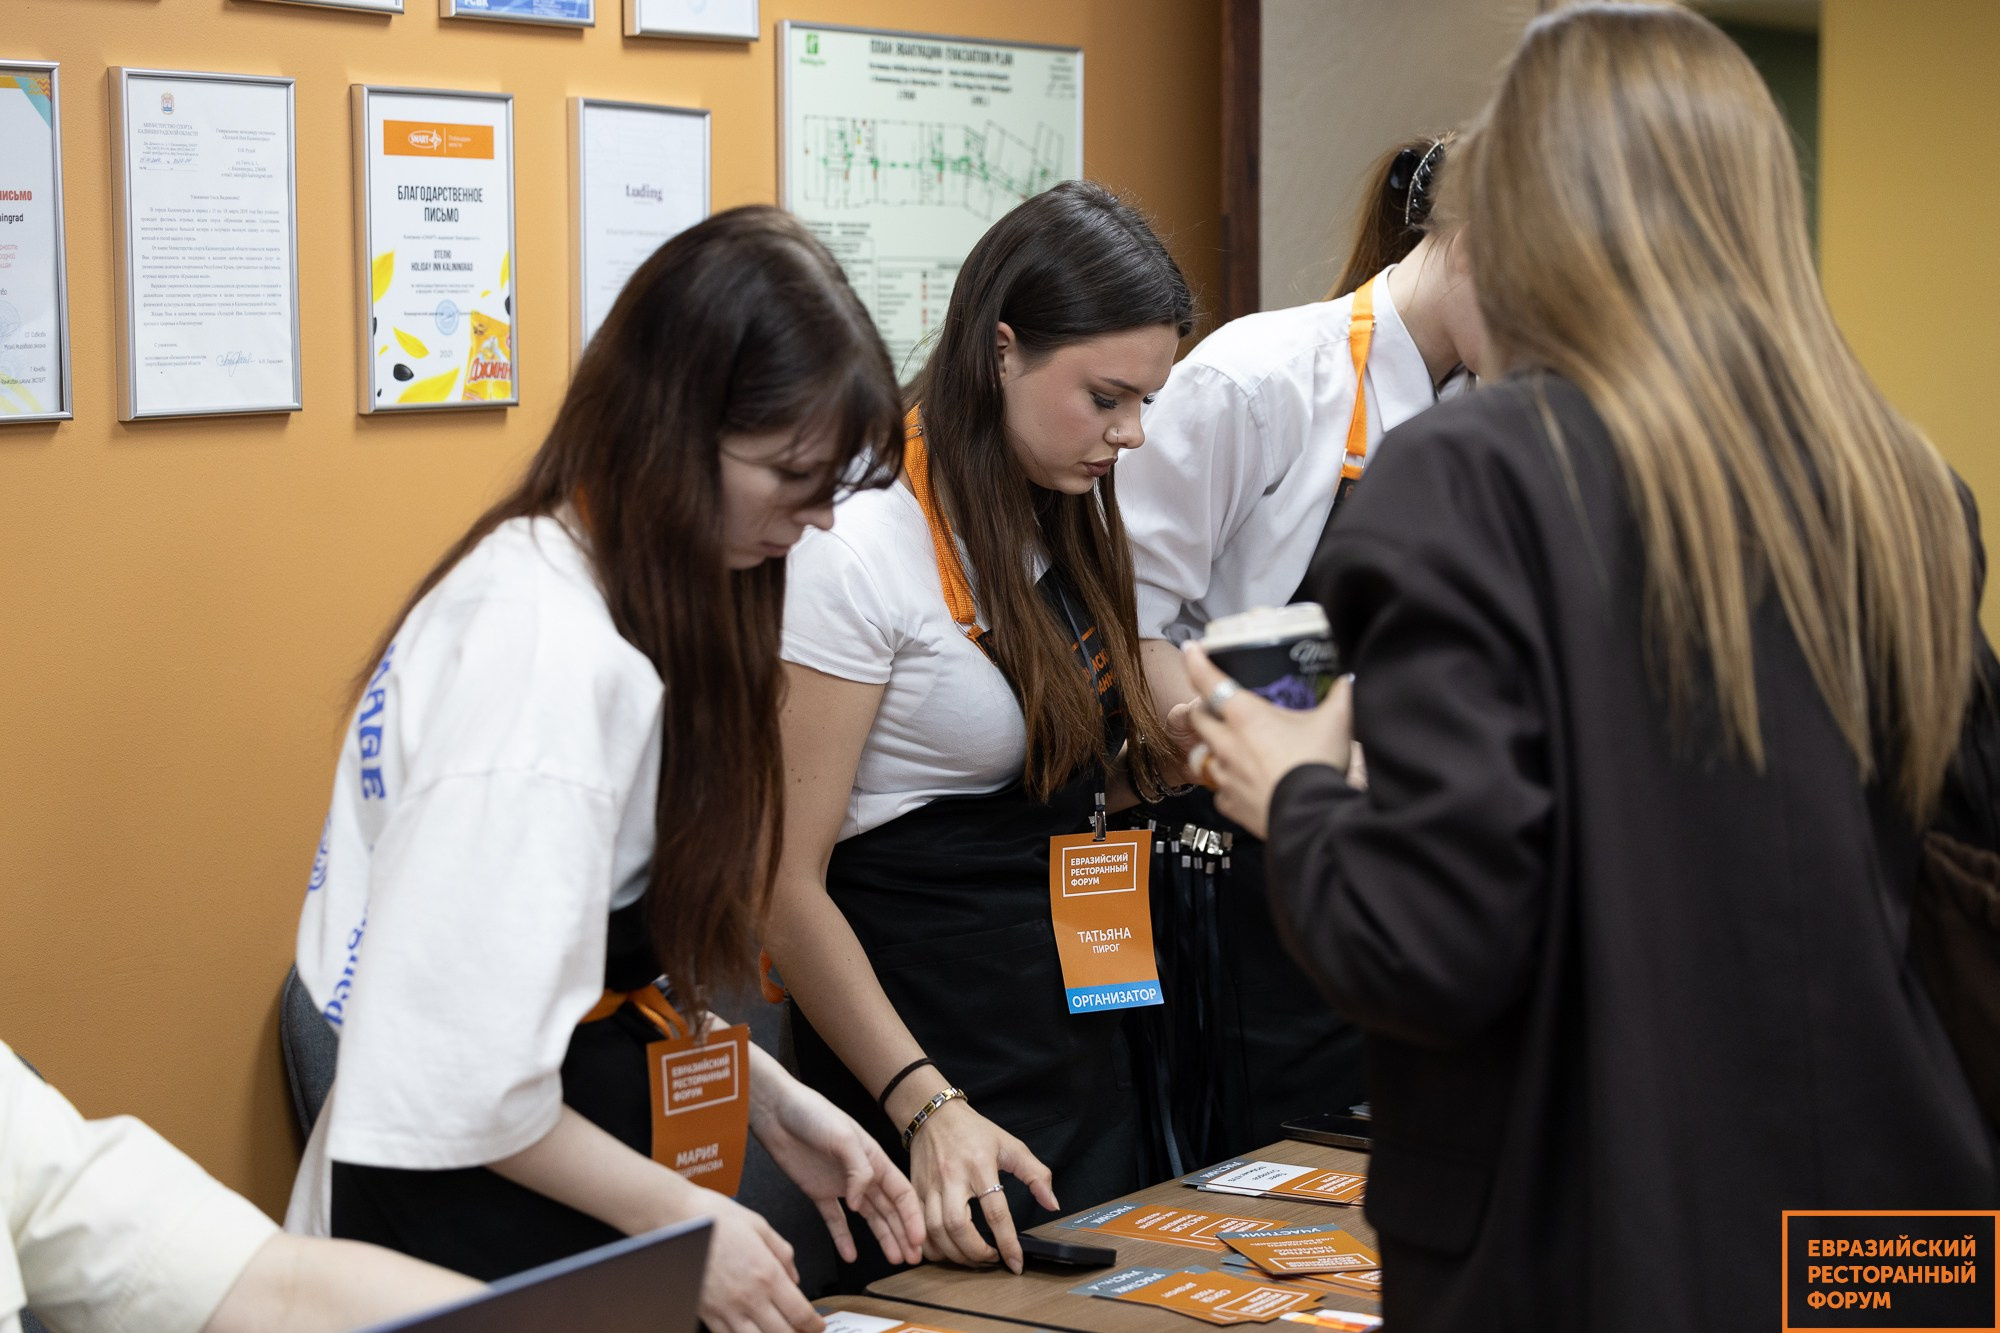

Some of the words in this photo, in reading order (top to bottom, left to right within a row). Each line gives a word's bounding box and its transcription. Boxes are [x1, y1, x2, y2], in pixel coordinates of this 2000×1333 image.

[397, 185, 484, 203] БЛАГОДАРСТВЕННОЕ
[0, 213, 24, 224] ingrad
[424, 207, 459, 222] ПИСЬМО
[1070, 852, 1129, 866] ЕВРАЗИЙСКИЙ
[1070, 863, 1129, 877] РЕСТОРАННЫЙ
[1070, 877, 1100, 887] ФОРУМ
[1077, 927, 1132, 943] ТАТЬЯНА
[1092, 943, 1120, 954] ПИРОГ
[1072, 987, 1157, 1008] ОРГАНИЗАТОР
[671, 1053, 730, 1078] ЕВРАЗИЙСКИЙ
[672, 1067, 731, 1090] РЕСТОРАННЫЙ
[673, 1087, 703, 1102] ФОРУМ
[676, 1143, 719, 1167] МАРИЯ
[1238, 1227, 1321, 1238] УЧАСТНИК
